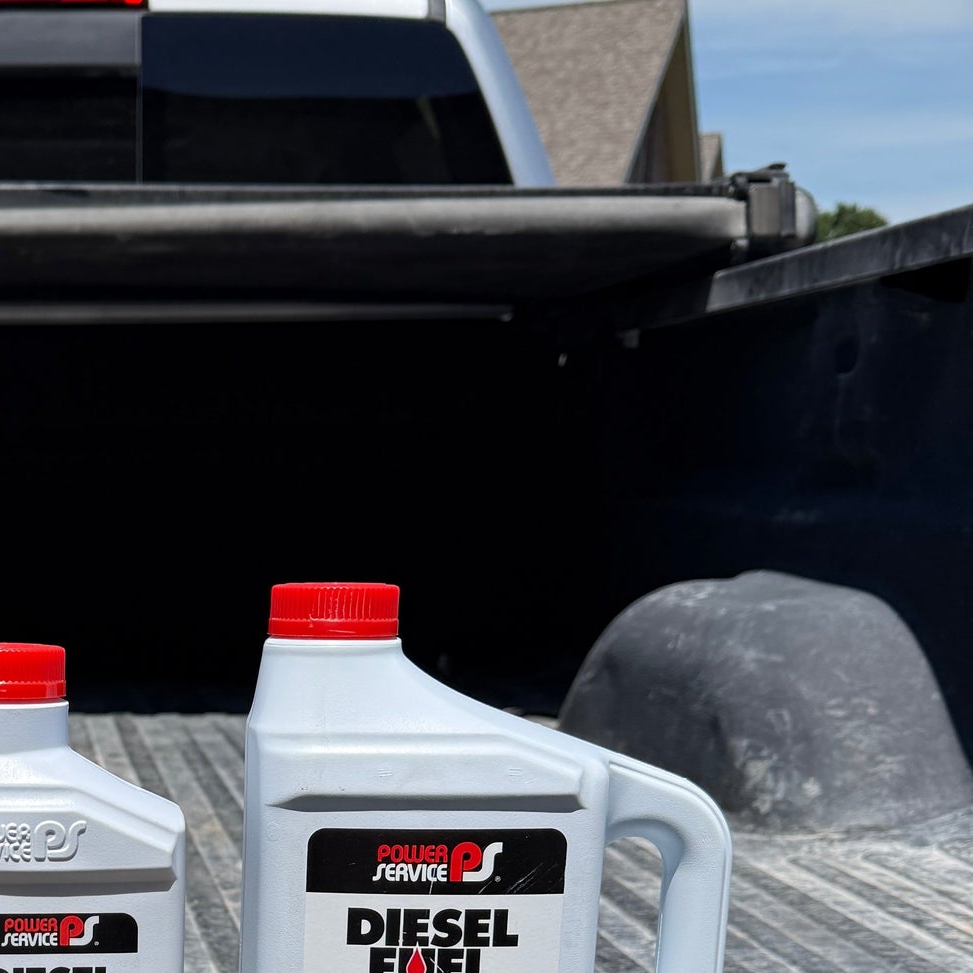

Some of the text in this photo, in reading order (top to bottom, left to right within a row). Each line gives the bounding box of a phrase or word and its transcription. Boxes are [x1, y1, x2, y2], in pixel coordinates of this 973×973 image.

[34, 820, 87, 862] PS
[376, 844, 448, 863] POWER
[372, 863, 448, 882] SERVICE
[3, 917, 58, 932] POWER
[346, 907, 519, 947] DIESEL
[1, 932, 58, 947] SERVICE
